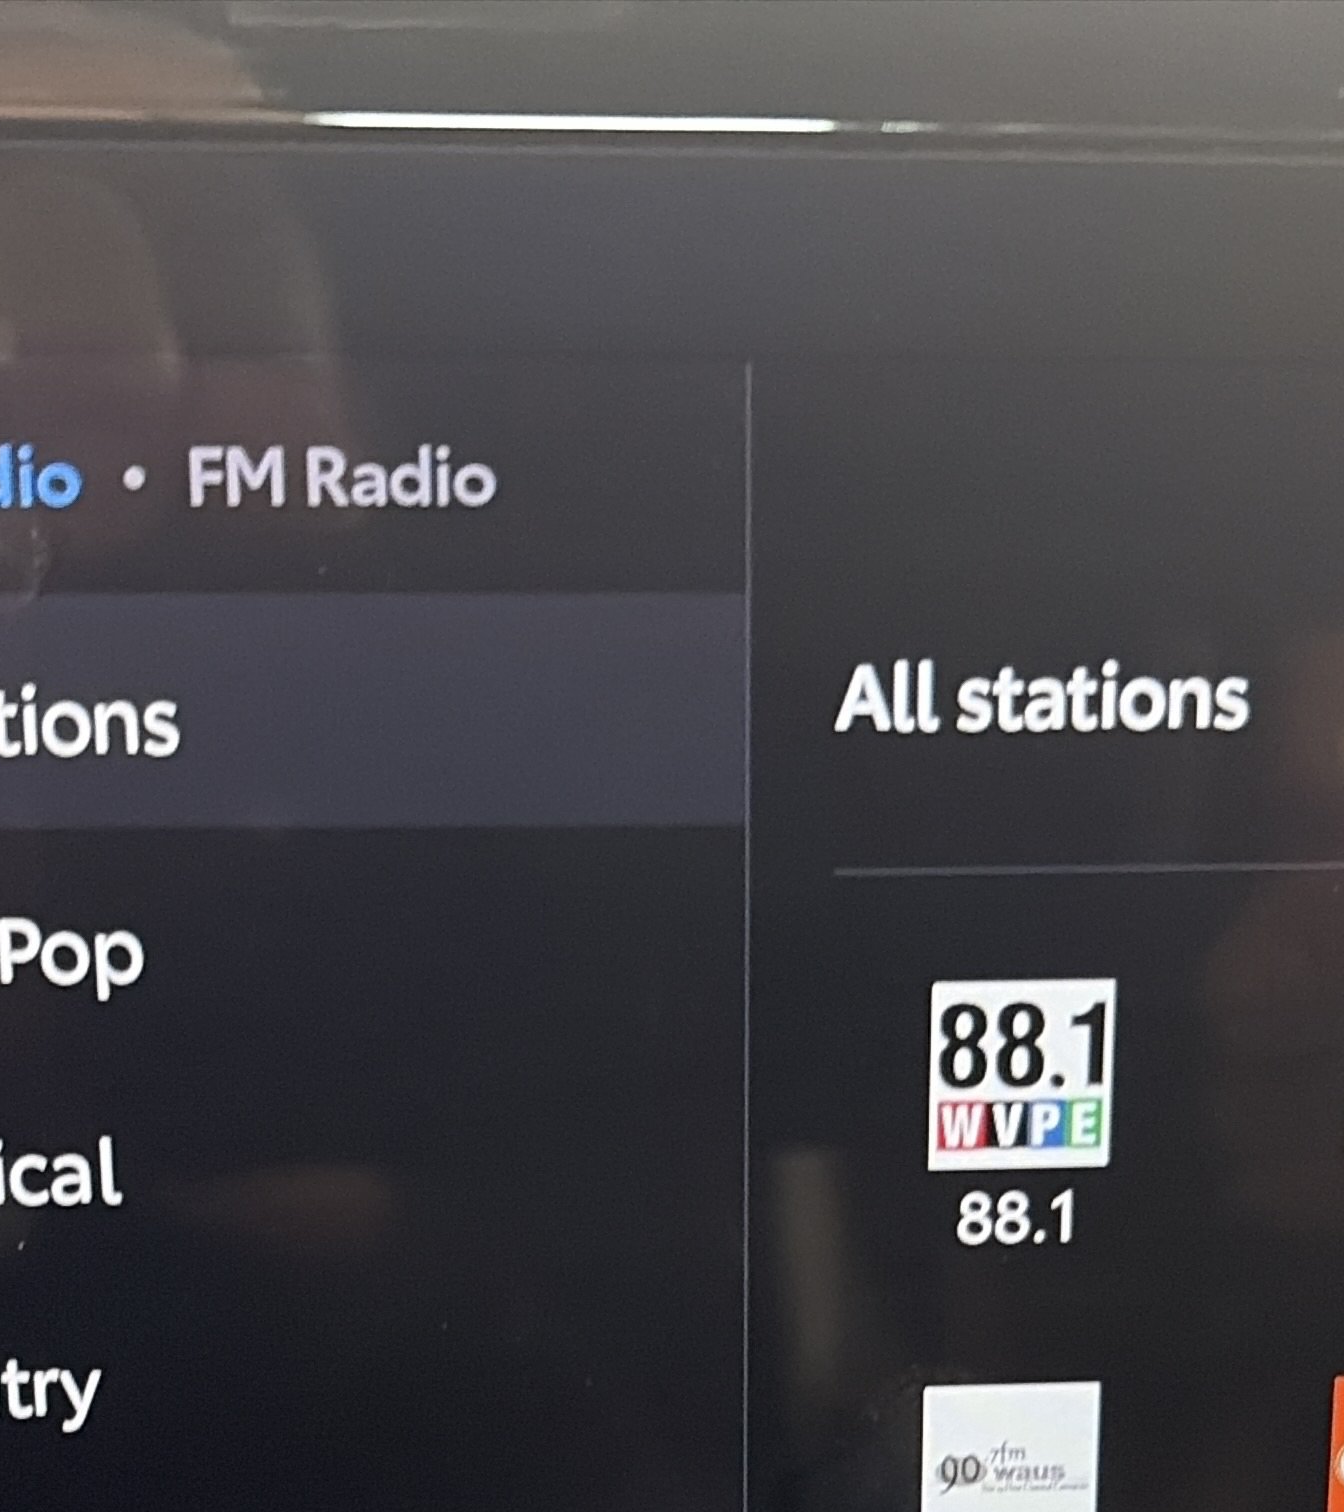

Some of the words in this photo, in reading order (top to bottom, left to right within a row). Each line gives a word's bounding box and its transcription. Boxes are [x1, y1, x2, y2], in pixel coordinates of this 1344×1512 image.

[188, 446, 287, 510] FM
[305, 444, 498, 509] Radio
[834, 661, 940, 735] All
[956, 659, 1251, 735] stations
[938, 1001, 1107, 1089] 88.1
[940, 1101, 1099, 1148] WVPE
[956, 1187, 1074, 1246] 88.1
